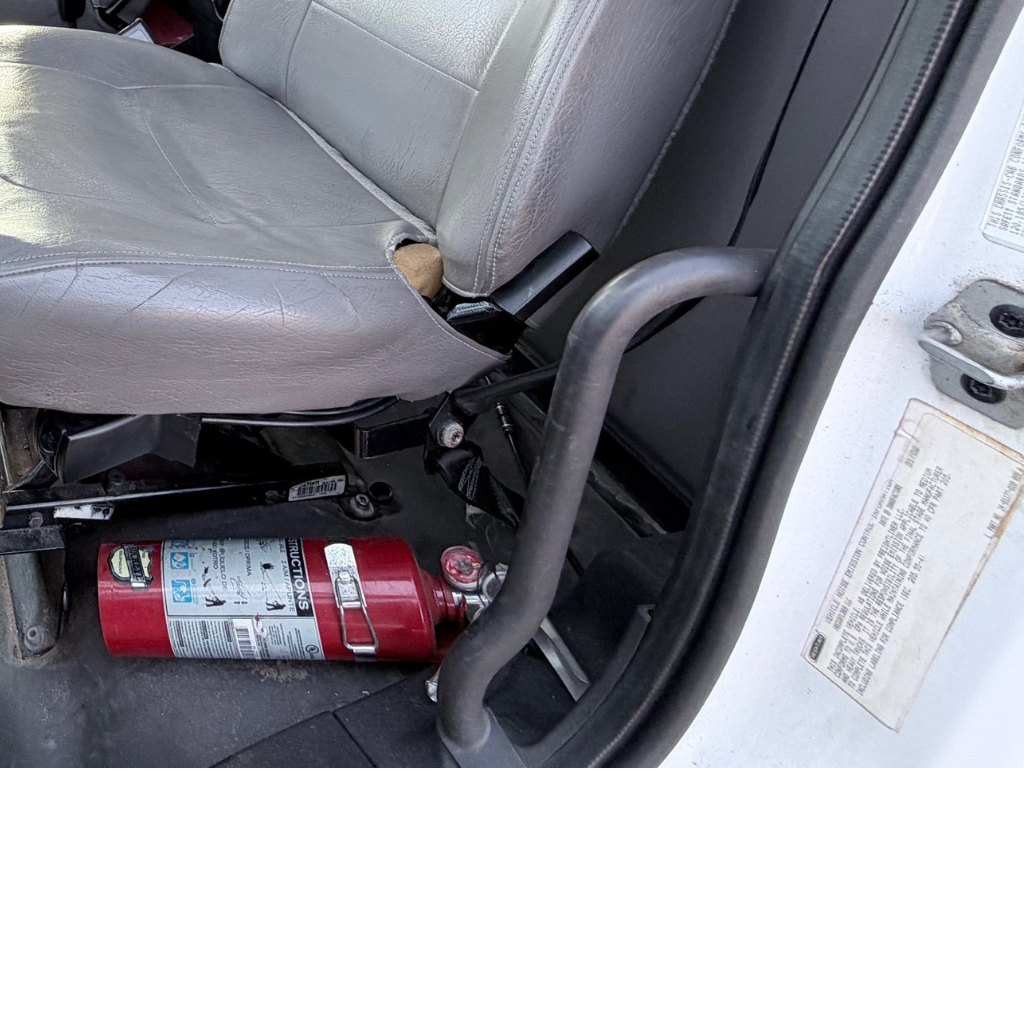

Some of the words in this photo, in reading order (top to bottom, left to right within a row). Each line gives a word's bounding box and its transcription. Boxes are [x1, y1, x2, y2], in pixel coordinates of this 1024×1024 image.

[986, 211, 998, 227] THIS
[993, 166, 1017, 209] CHASSIS-CAB
[999, 207, 1014, 231] SAFETY
[244, 553, 252, 576] OPRIMA
[288, 538, 309, 611] STRUCTIONS
[286, 582, 296, 613] APUNTE
[827, 659, 836, 672] THIS
[833, 629, 849, 659] INCOMPLETE
[861, 567, 877, 596] DELIVERED
[877, 520, 898, 559] FREIGHTLINER
